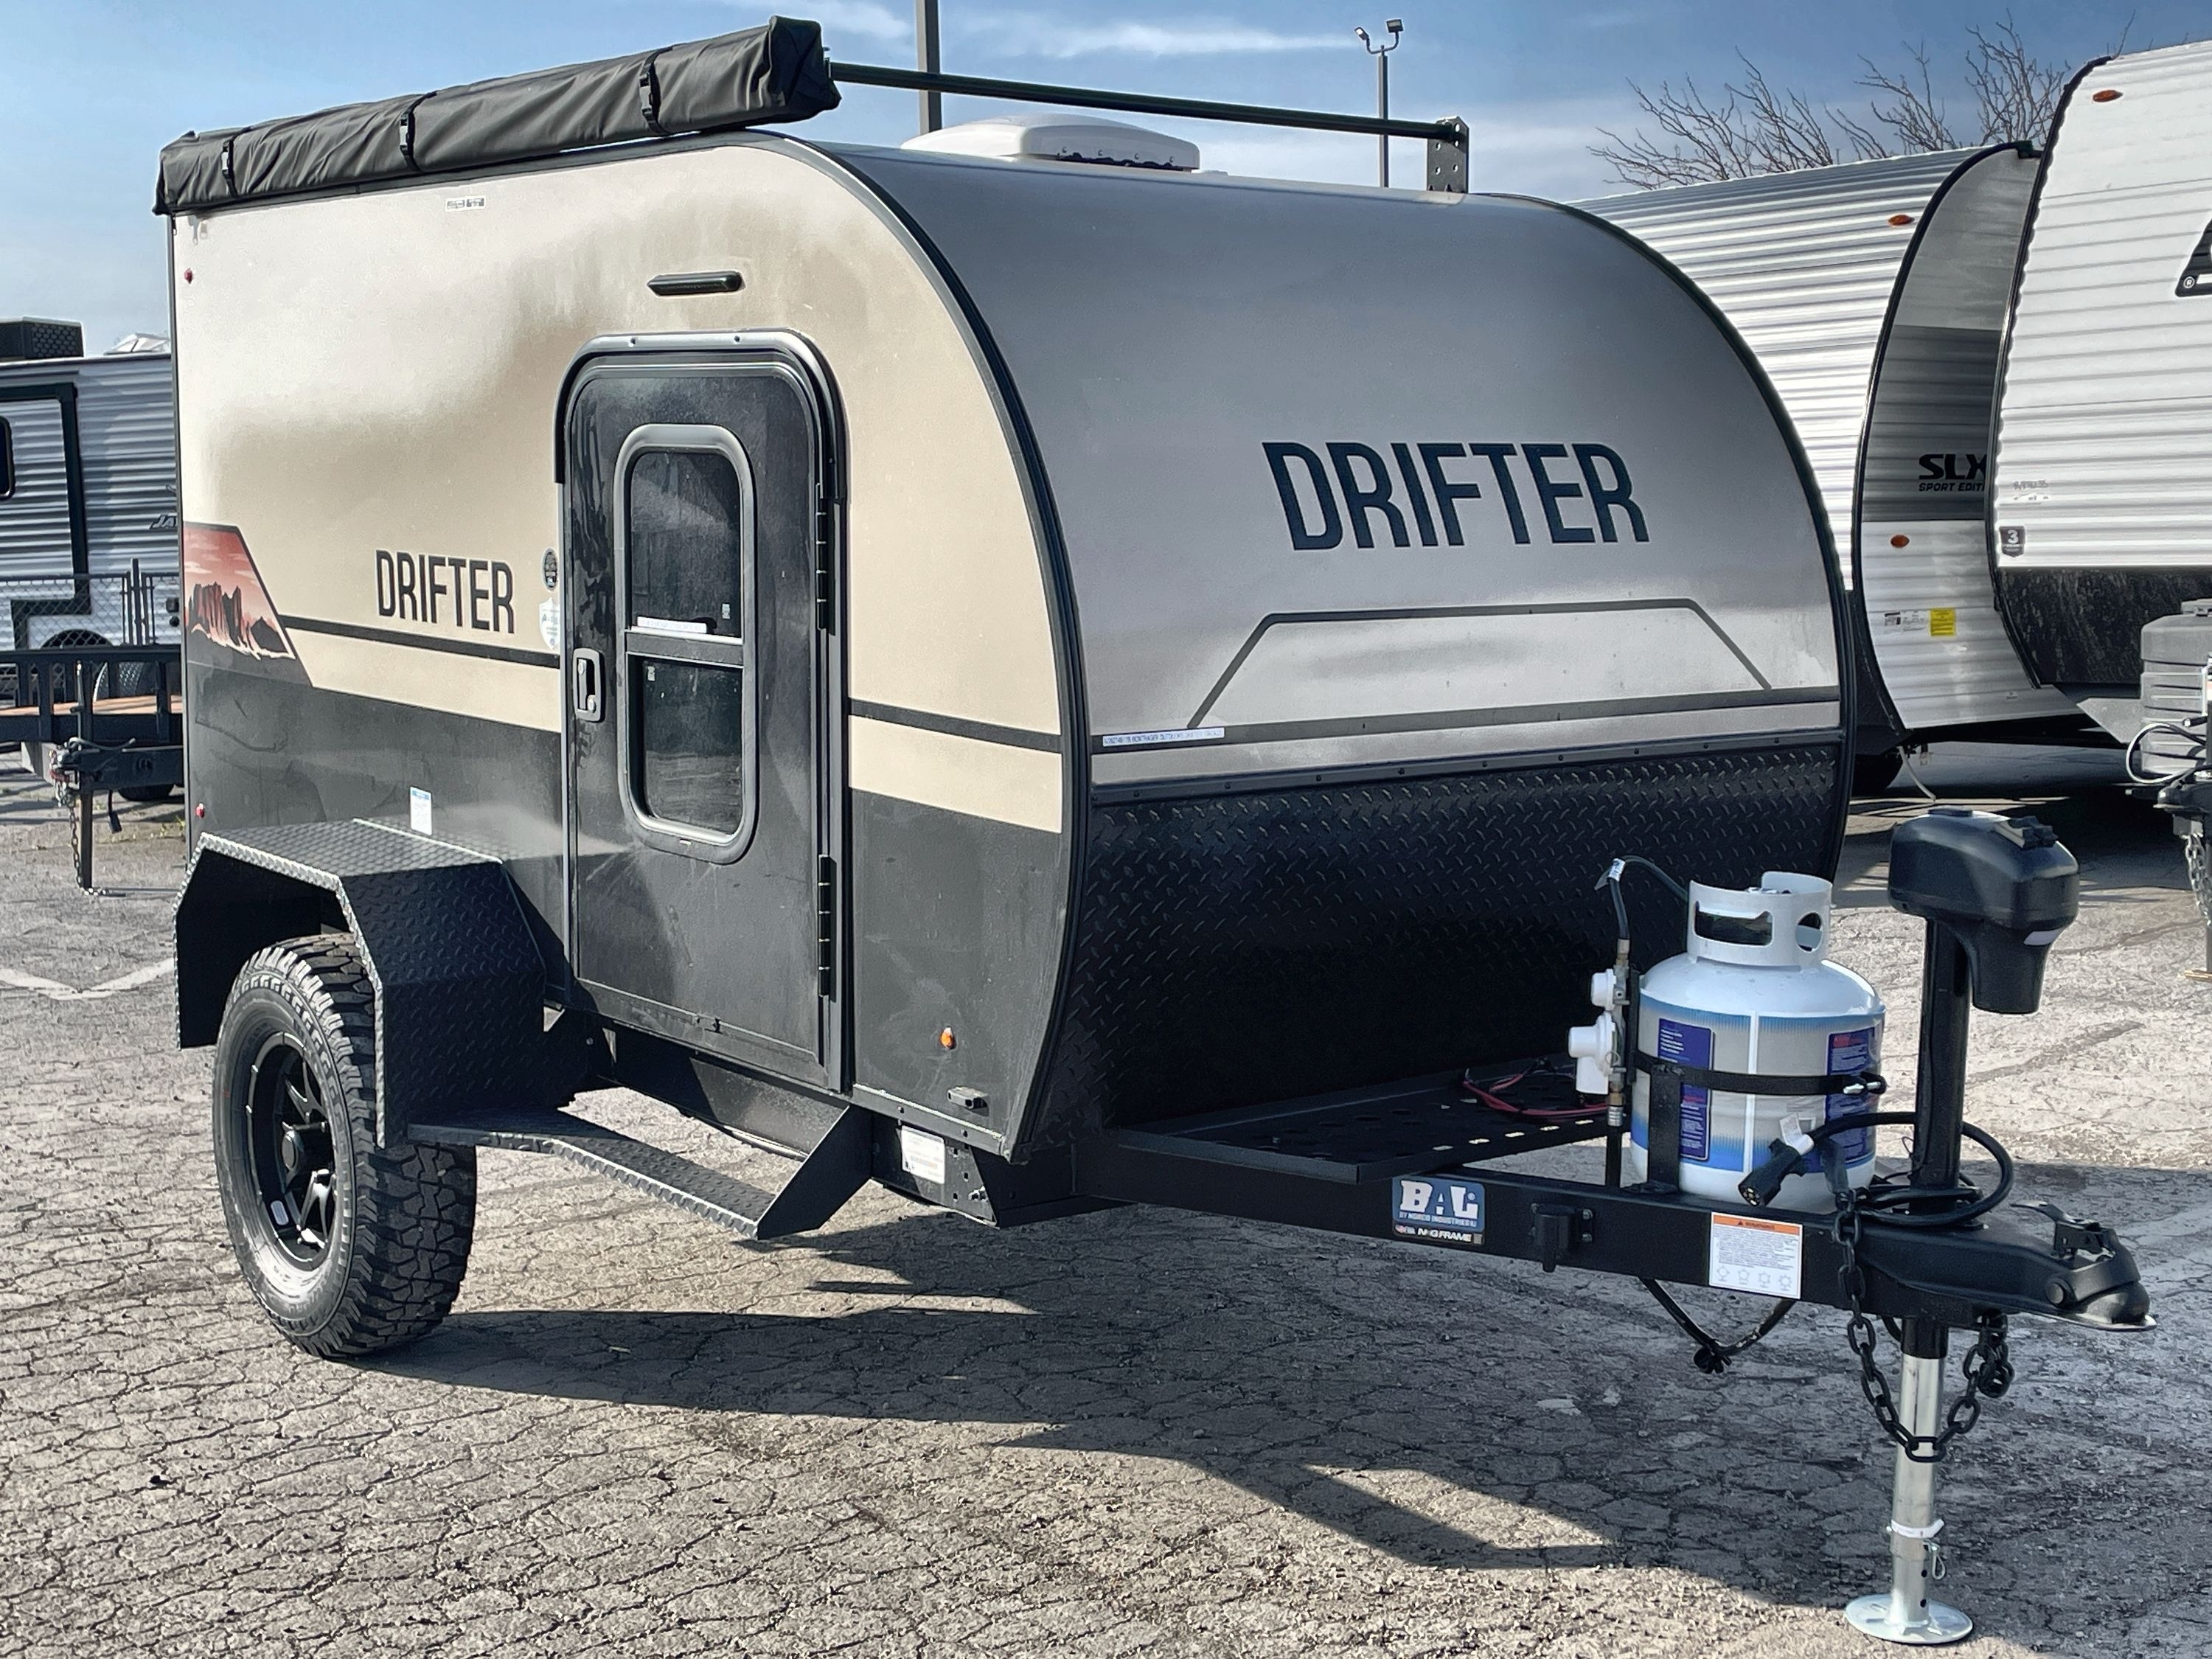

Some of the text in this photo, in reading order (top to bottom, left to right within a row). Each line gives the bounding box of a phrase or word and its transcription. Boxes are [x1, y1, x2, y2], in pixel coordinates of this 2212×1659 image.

[1262, 442, 1650, 551] DRIFTER
[1919, 482, 1955, 492] SPORT
[2007, 529, 2019, 544] 3
[375, 550, 515, 634] DRIFTER
[1400, 1180, 1478, 1220] BAL
